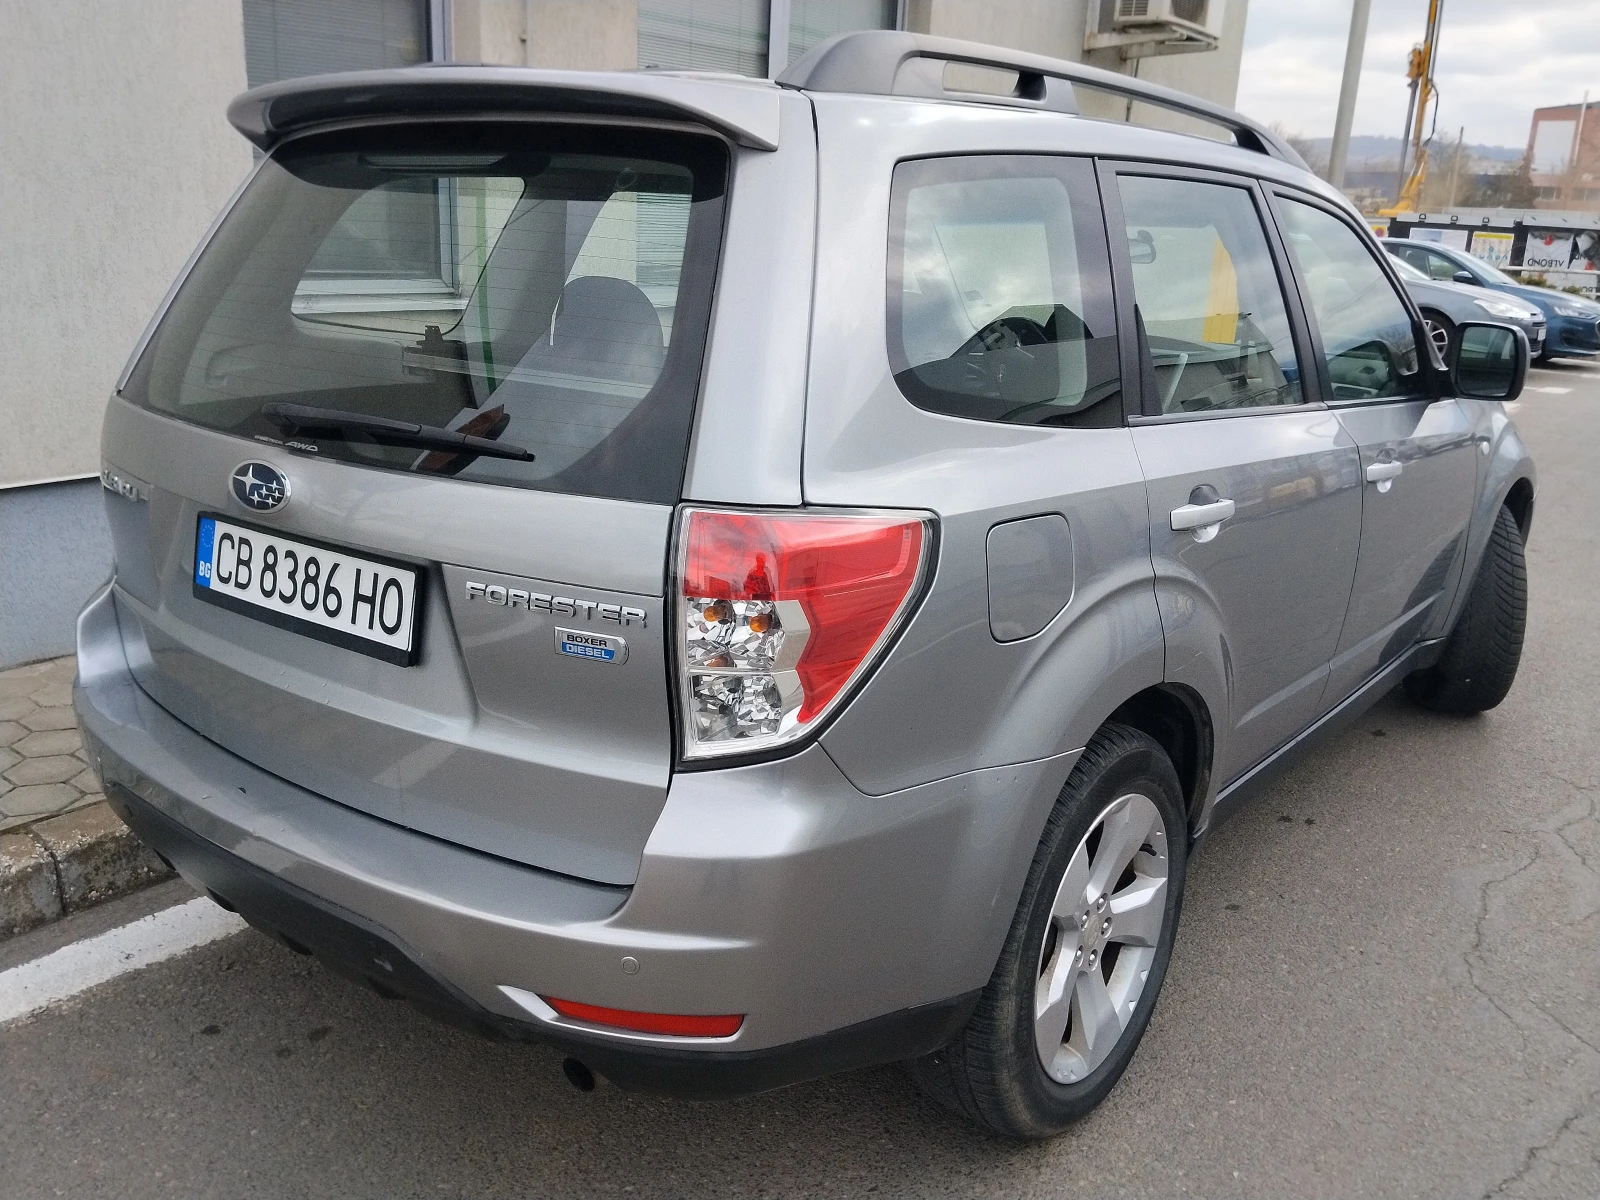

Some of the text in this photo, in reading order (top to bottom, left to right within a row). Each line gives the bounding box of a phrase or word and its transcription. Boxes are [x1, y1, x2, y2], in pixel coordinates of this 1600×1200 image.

[1527, 258, 1565, 268] ALBOND
[285, 441, 319, 452] AWD
[198, 560, 212, 579] BG
[216, 532, 404, 636] CB 8386 HO
[466, 581, 648, 628] FORESTER
[566, 634, 608, 648] BOXER
[566, 644, 610, 660] DIESEL
